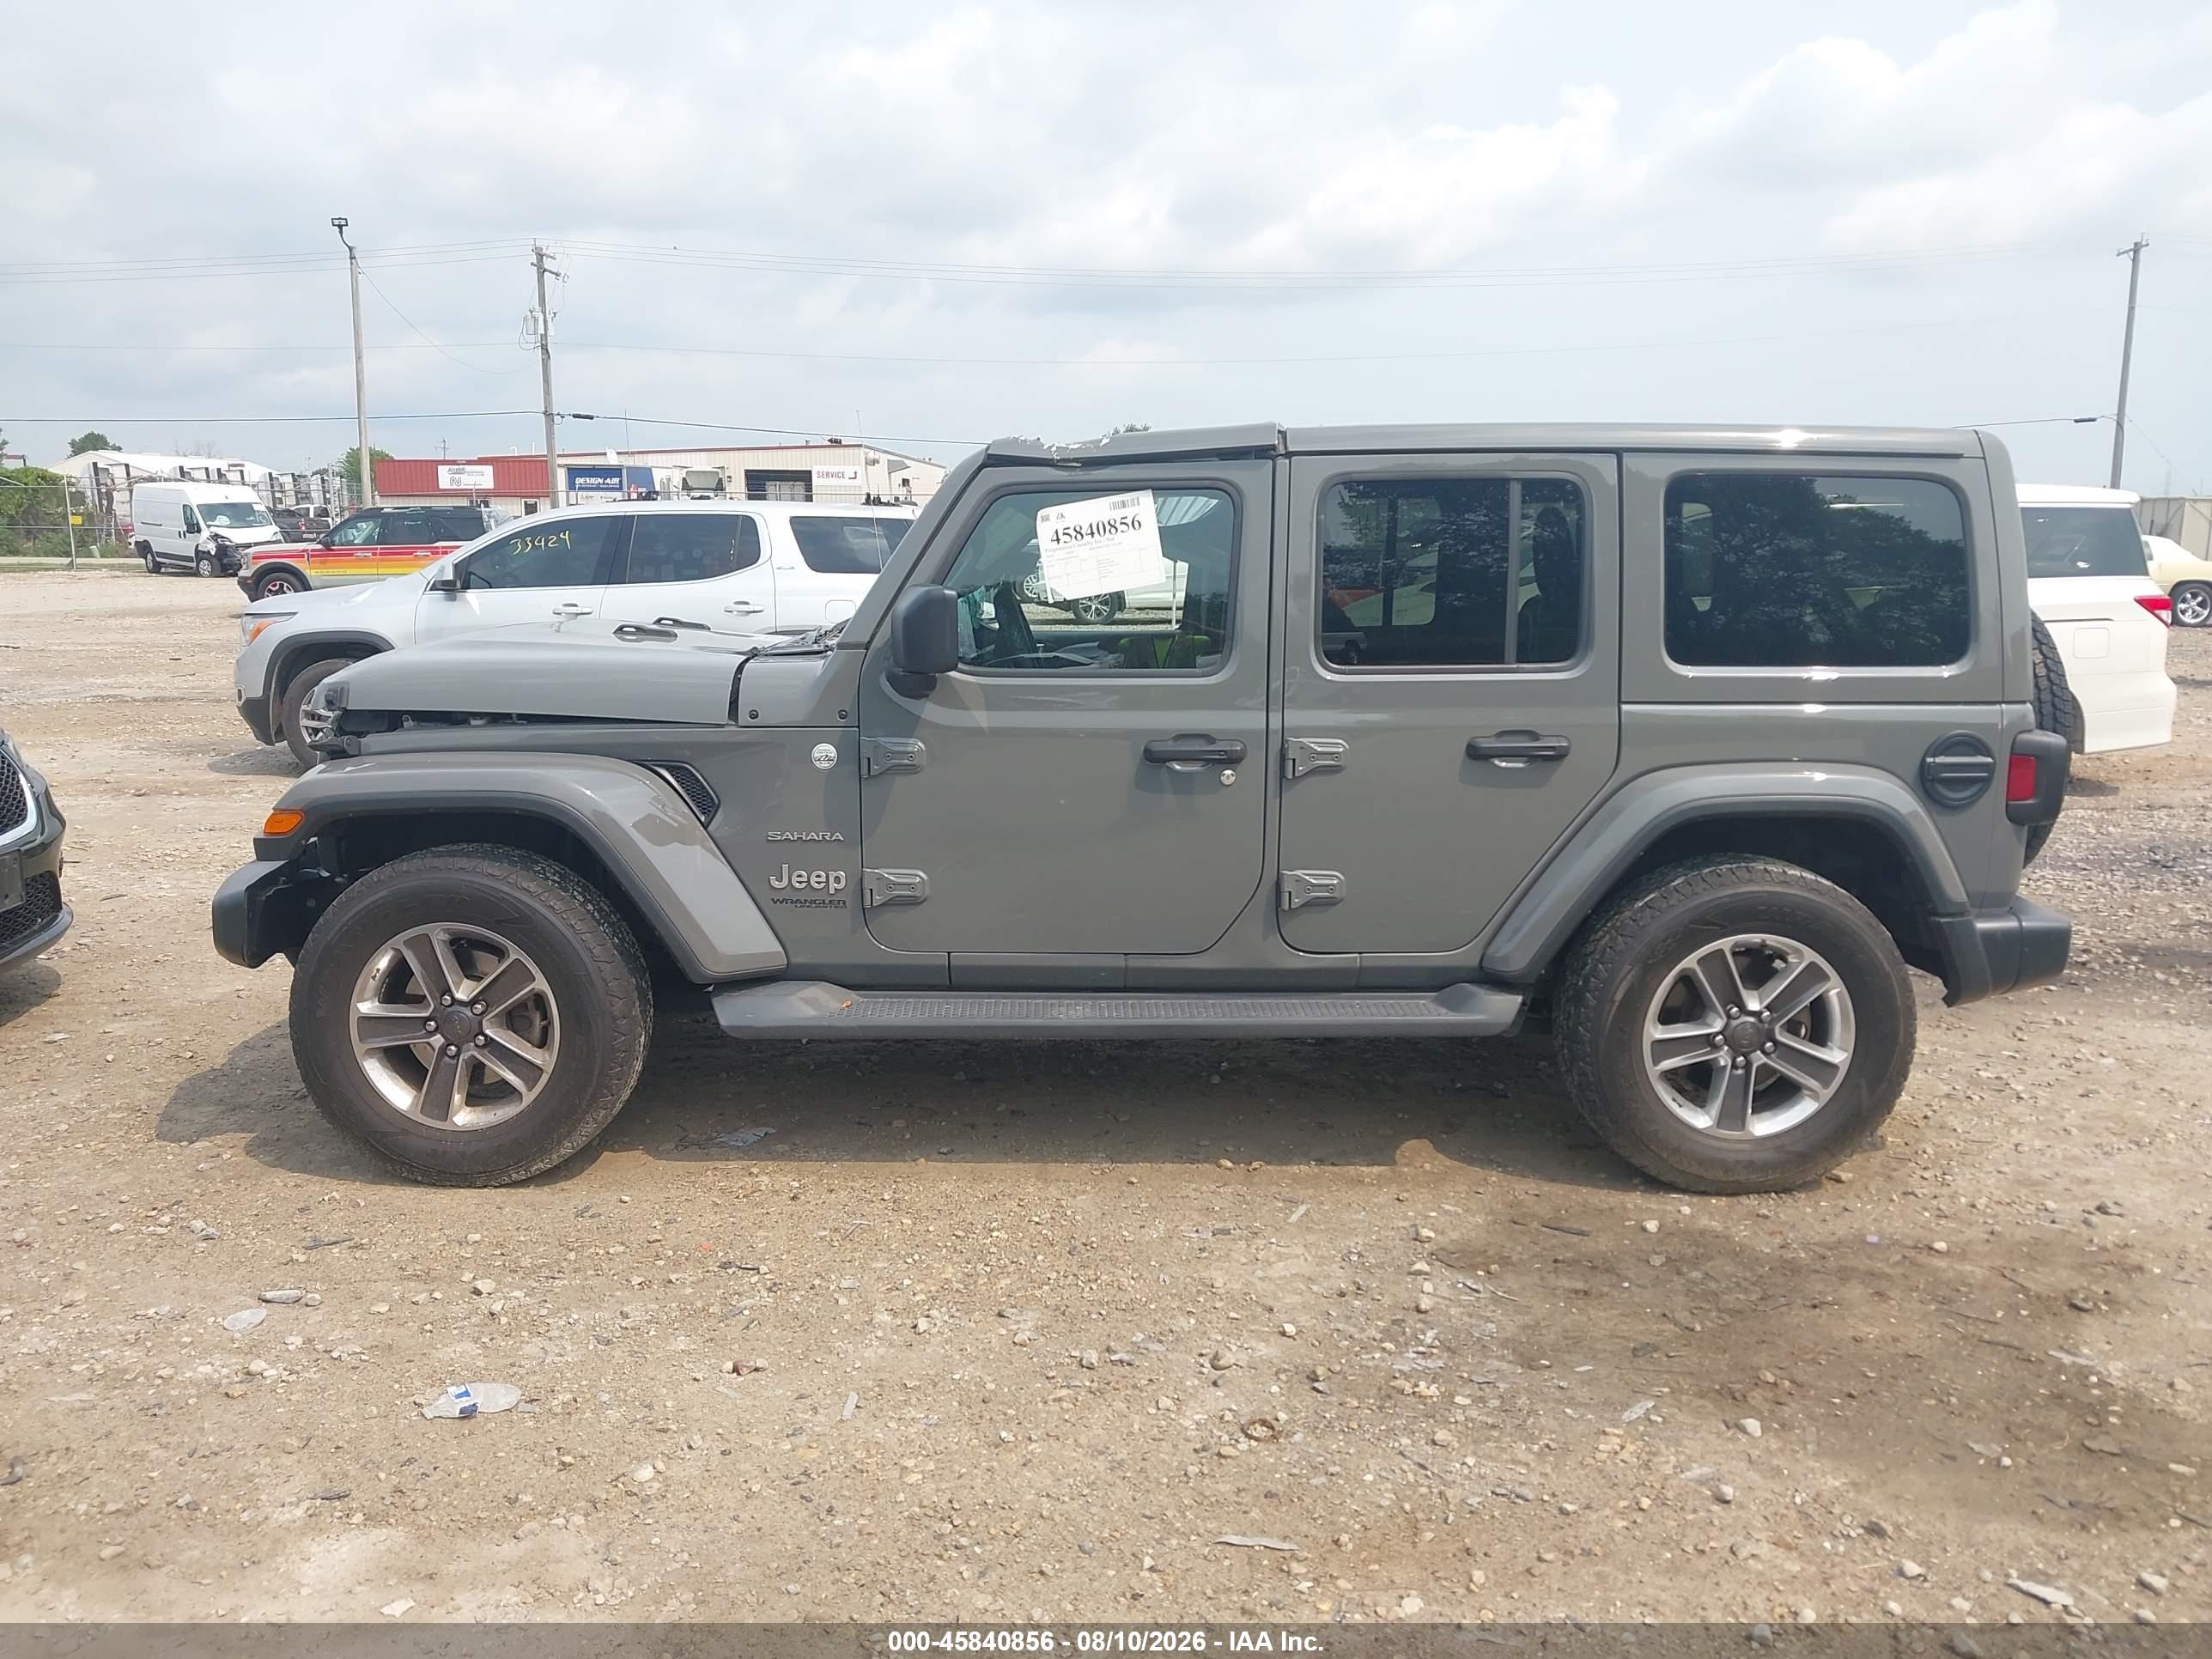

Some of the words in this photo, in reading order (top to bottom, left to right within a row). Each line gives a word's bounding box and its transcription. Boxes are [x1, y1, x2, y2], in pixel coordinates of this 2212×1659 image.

[817, 471, 846, 479] SERVICE
[1050, 513, 1142, 545] 45840856
[767, 830, 845, 842] SAHARA
[769, 864, 847, 894] Jeep
